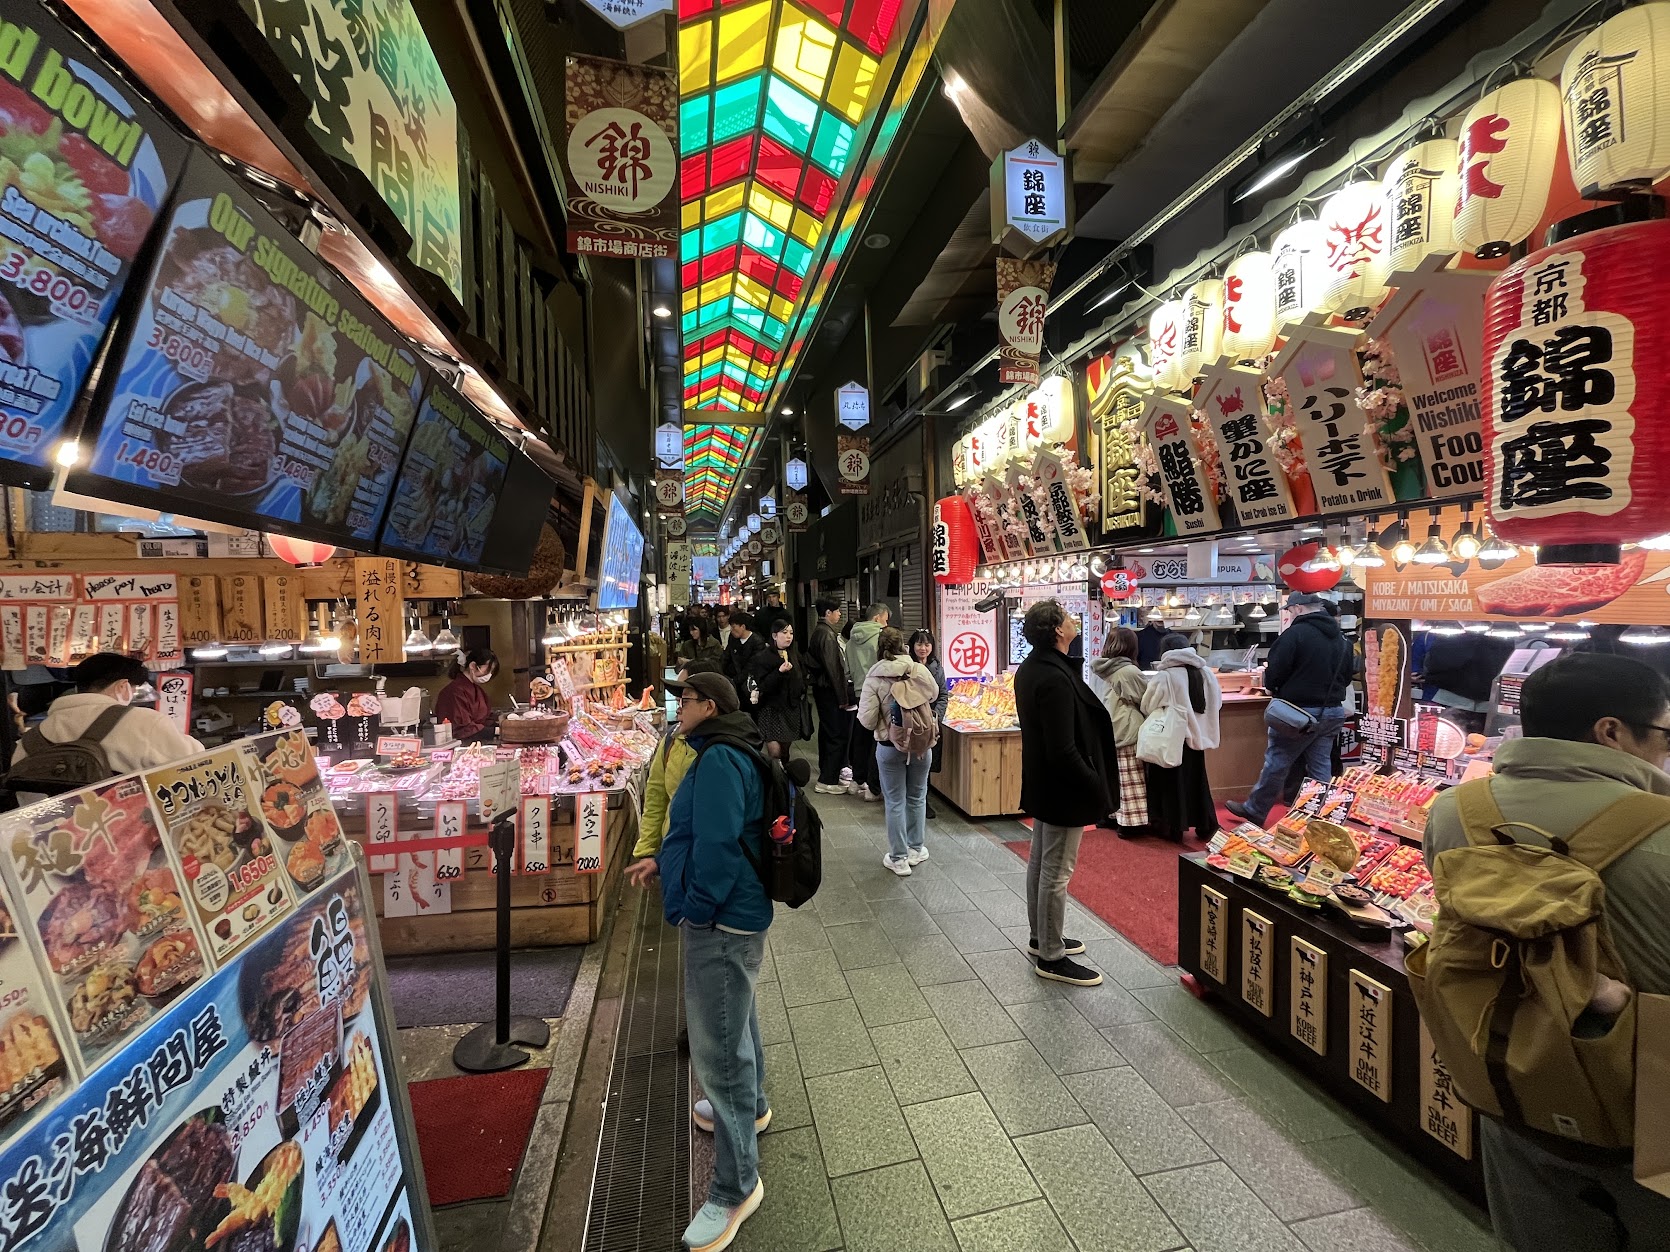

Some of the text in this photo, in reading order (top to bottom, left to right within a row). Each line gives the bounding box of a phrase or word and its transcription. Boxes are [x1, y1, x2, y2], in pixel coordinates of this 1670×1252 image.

[32, 48, 143, 166] bowl
[1576, 86, 1612, 155] 錦座
[584, 121, 653, 201] 錦
[585, 181, 629, 197] NISHIKI
[1023, 169, 1047, 215] 錦座
[1023, 222, 1049, 233] 飲食街
[1396, 194, 1423, 243] 錦座
[577, 235, 668, 257] 錦市場商店街
[208, 192, 418, 389] Our signature seafood bowl
[1277, 268, 1297, 308] 錦座
[1532, 260, 1569, 327] 京都
[1009, 295, 1046, 345] 錦
[1009, 334, 1036, 343] NISHIKI
[1005, 369, 1039, 385] 錦市場商
[1413, 382, 1477, 410] Welcome
[1417, 400, 1482, 433] Nishiki
[1500, 324, 1616, 511] 錦座
[1430, 431, 1483, 460] Foo
[1106, 428, 1139, 514] 錦座
[1431, 461, 1483, 488] Cou
[1321, 493, 1350, 508] Potato
[1356, 487, 1383, 503] Drink
[1184, 518, 1205, 530] Sushi
[383, 559, 397, 596] 自慢の
[1153, 561, 1188, 579] むら
[85, 576, 173, 599] please pay here
[1373, 582, 1397, 596] KOBE
[1408, 580, 1469, 595] MATSUSAKA
[362, 569, 384, 660] 溢れる肉汁
[1373, 598, 1411, 612] MIYAZAKI
[1421, 598, 1437, 612] OMI
[1449, 597, 1473, 612] SAGA
[953, 637, 987, 669] 油
[1380, 721, 1399, 731] BEEF
[157, 762, 245, 813] きつねうどん
[581, 802, 599, 841] 生ウニ
[228, 853, 277, 895] 1,650円
[1205, 960, 1219, 977] BEEF
[1249, 935, 1263, 981] 松阪牛
[1247, 990, 1264, 1010] BEEF
[1299, 967, 1315, 1018] 神戸牛
[1296, 1015, 1318, 1036] KOBE
[1296, 1028, 1318, 1046] BEEF
[1360, 1004, 1378, 1061] 近江牛
[1356, 1068, 1380, 1093] BEEF
[1358, 1057, 1378, 1079] OMI
[1427, 1105, 1458, 1133] SAGA
[1428, 1119, 1459, 1148] BEEF
